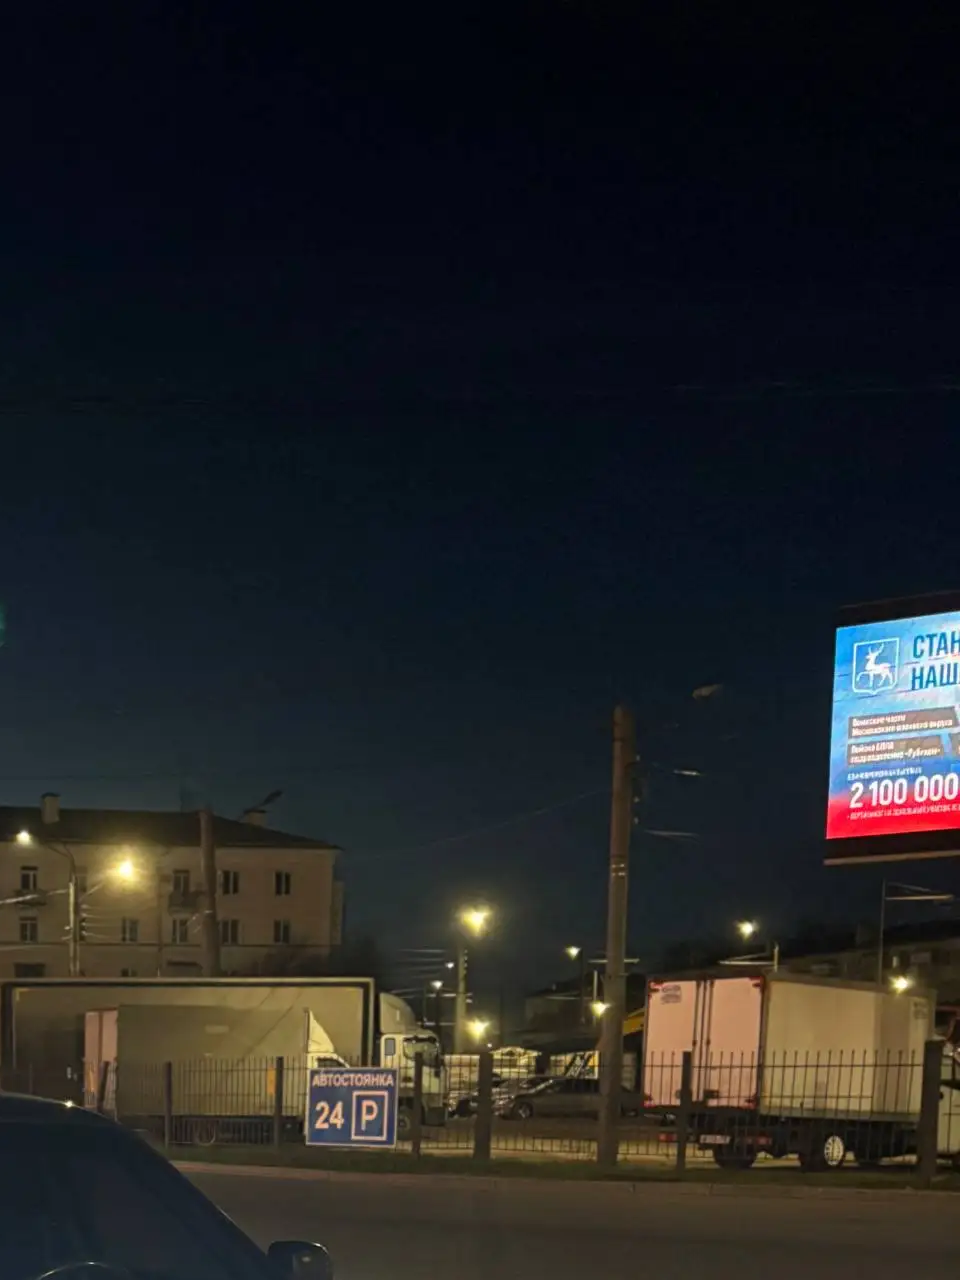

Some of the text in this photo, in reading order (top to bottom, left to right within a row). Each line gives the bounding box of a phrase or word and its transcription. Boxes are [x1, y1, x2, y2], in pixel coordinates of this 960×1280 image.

[911, 662, 960, 691] НАШ
[849, 782, 864, 808] 2
[869, 778, 908, 806] 100
[914, 772, 959, 803] 000
[312, 1073, 394, 1087] АВТОСТОЯНКА
[315, 1100, 345, 1129] 24
